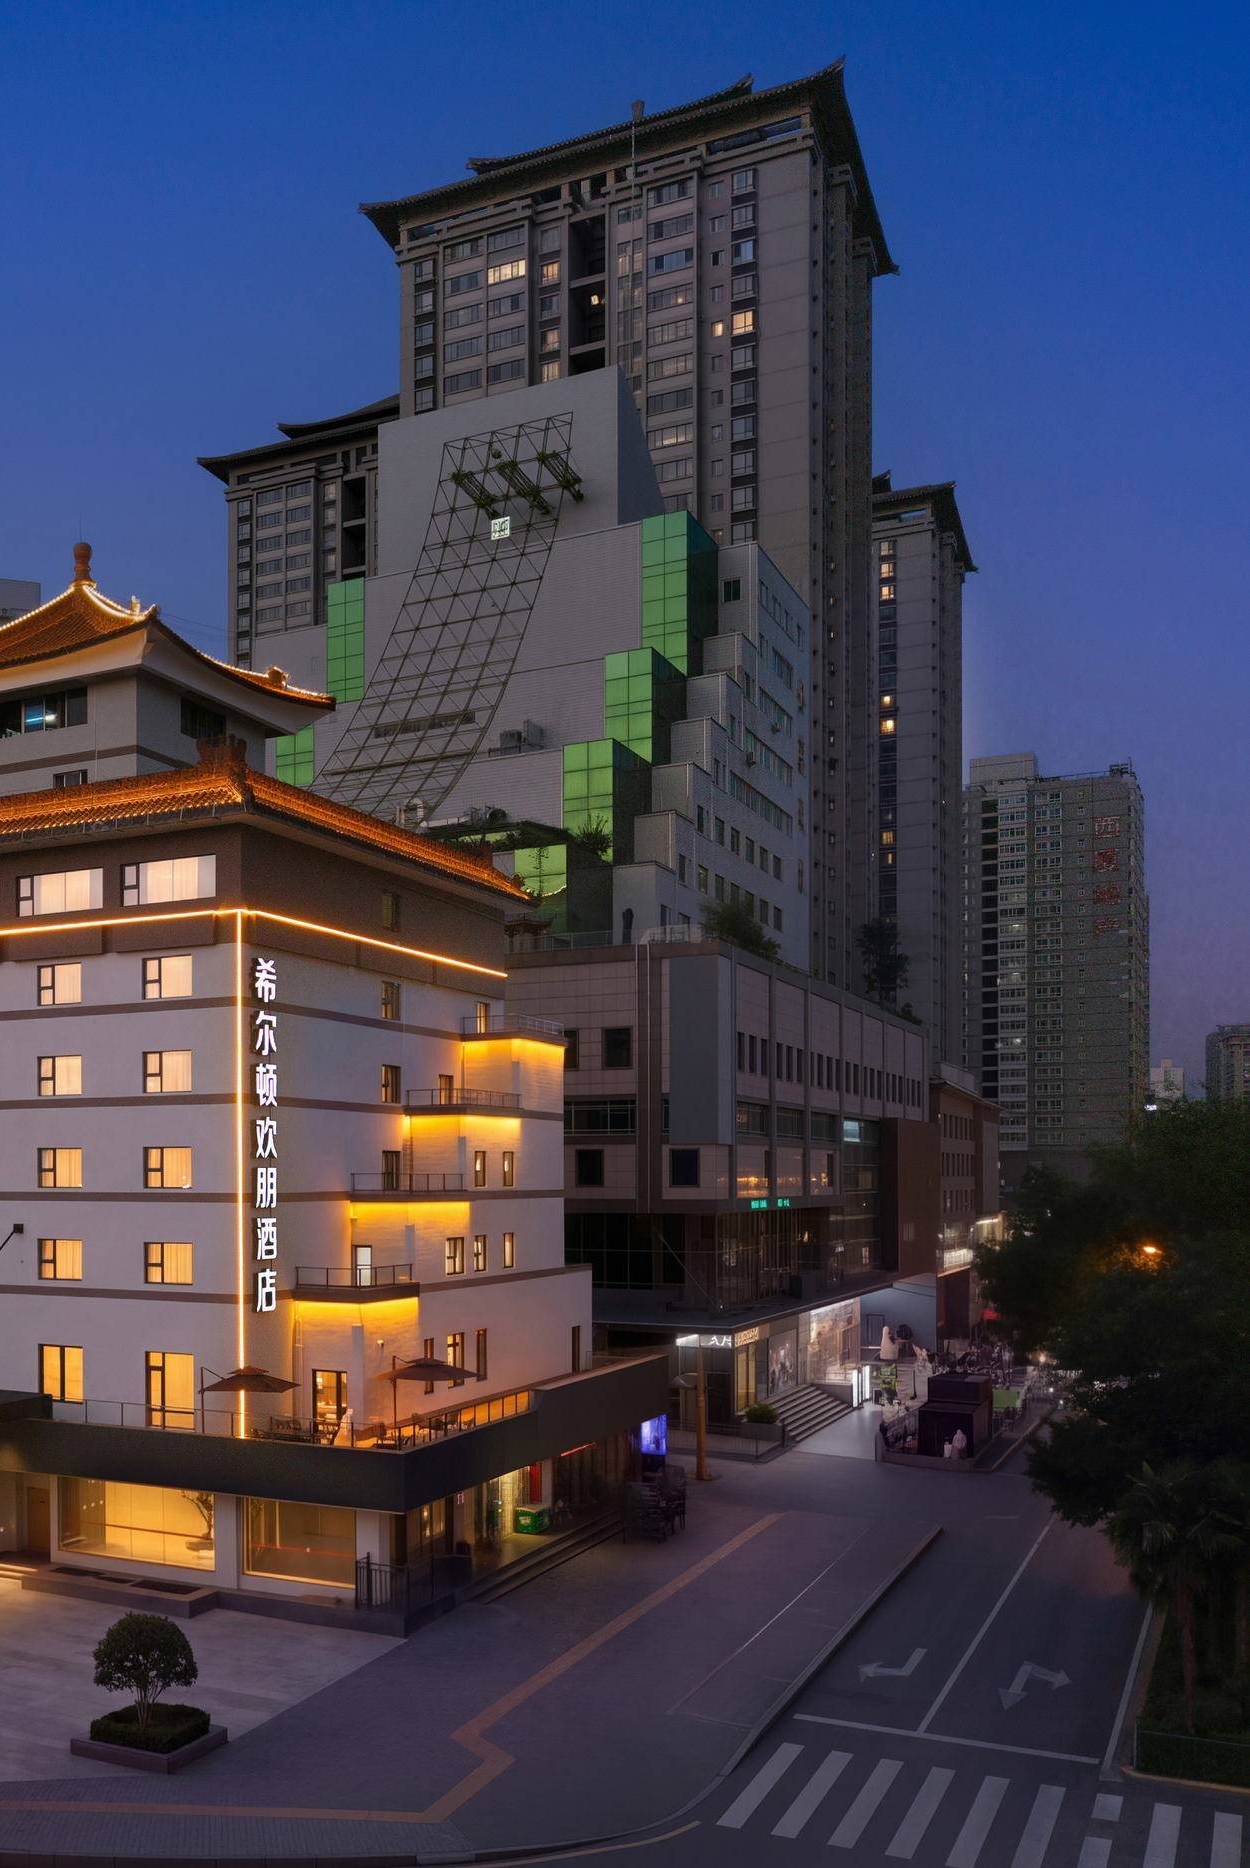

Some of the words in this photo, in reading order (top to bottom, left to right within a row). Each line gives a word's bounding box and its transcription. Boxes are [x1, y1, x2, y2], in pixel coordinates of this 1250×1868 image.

[255, 957, 278, 1312] 希尔顿欢朋酒店
